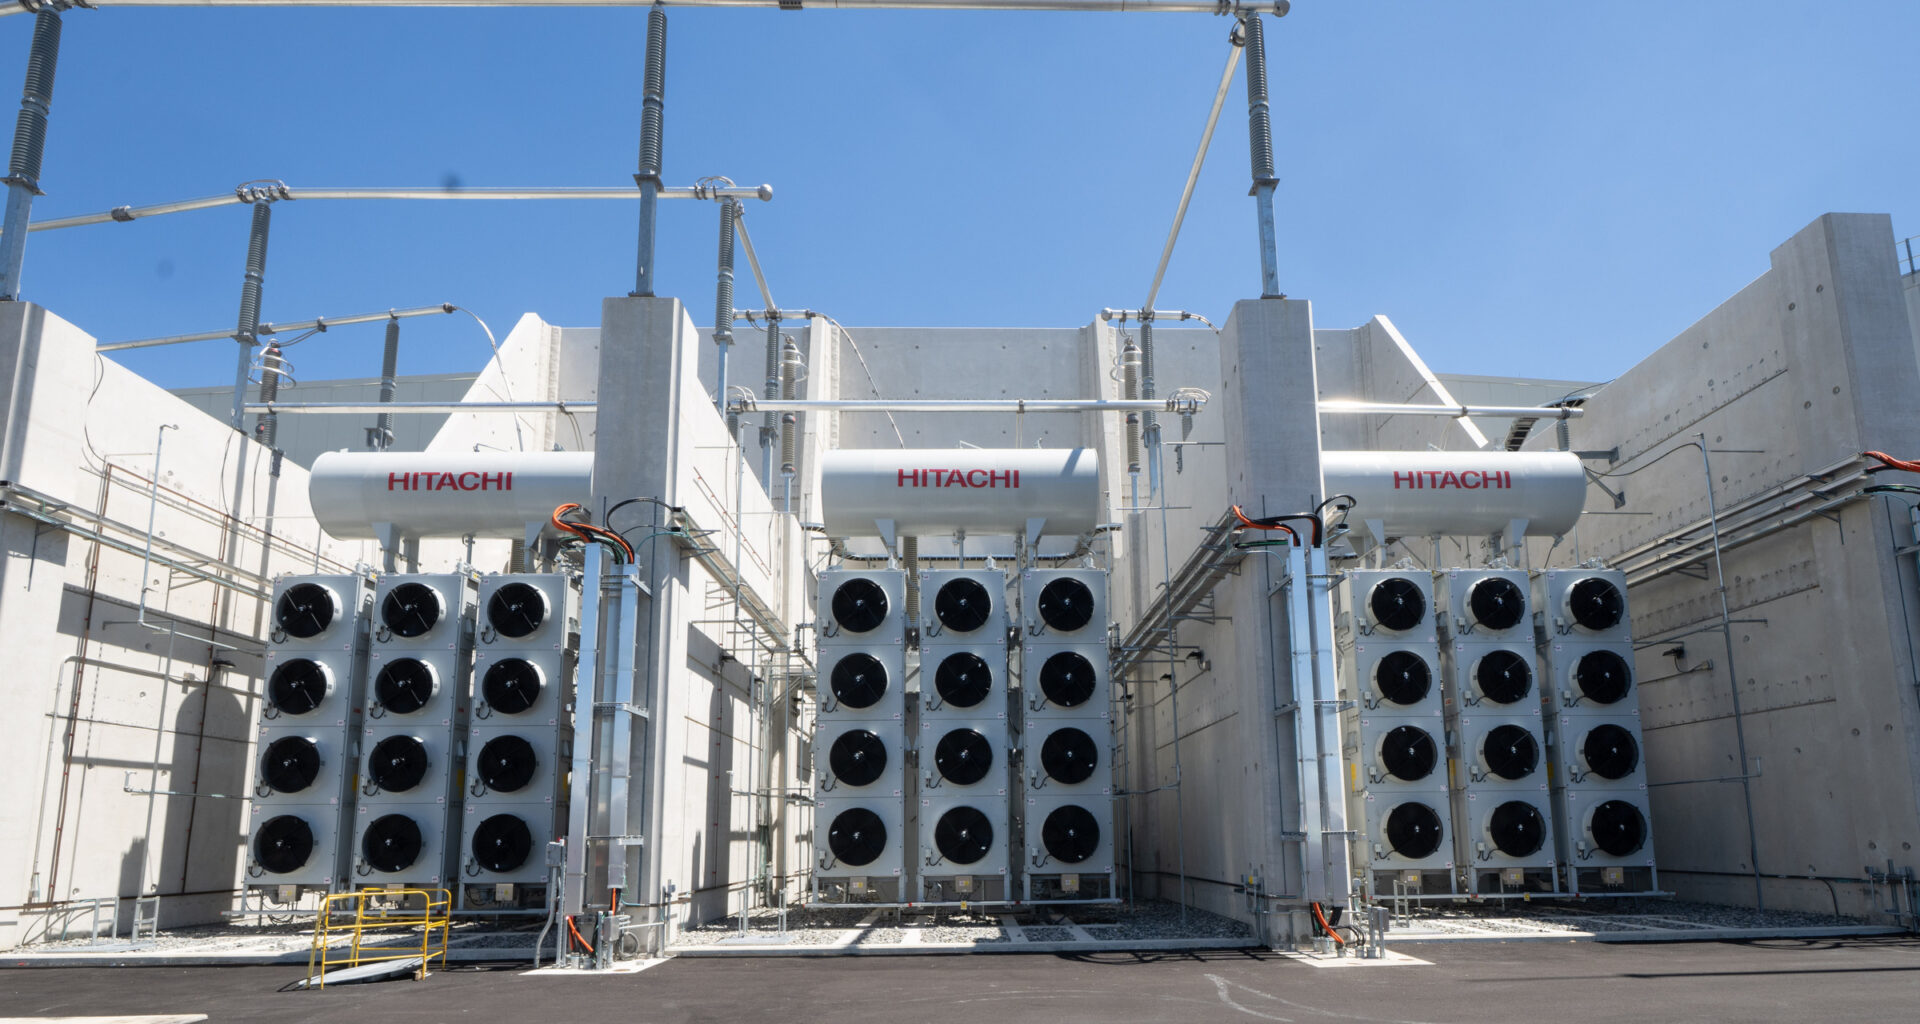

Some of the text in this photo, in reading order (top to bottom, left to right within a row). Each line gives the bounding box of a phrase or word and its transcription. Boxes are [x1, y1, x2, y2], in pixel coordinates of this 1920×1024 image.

[388, 471, 513, 491] HITACHI
[897, 468, 1020, 489] HITACHI
[1393, 470, 1512, 489] HITACHI
